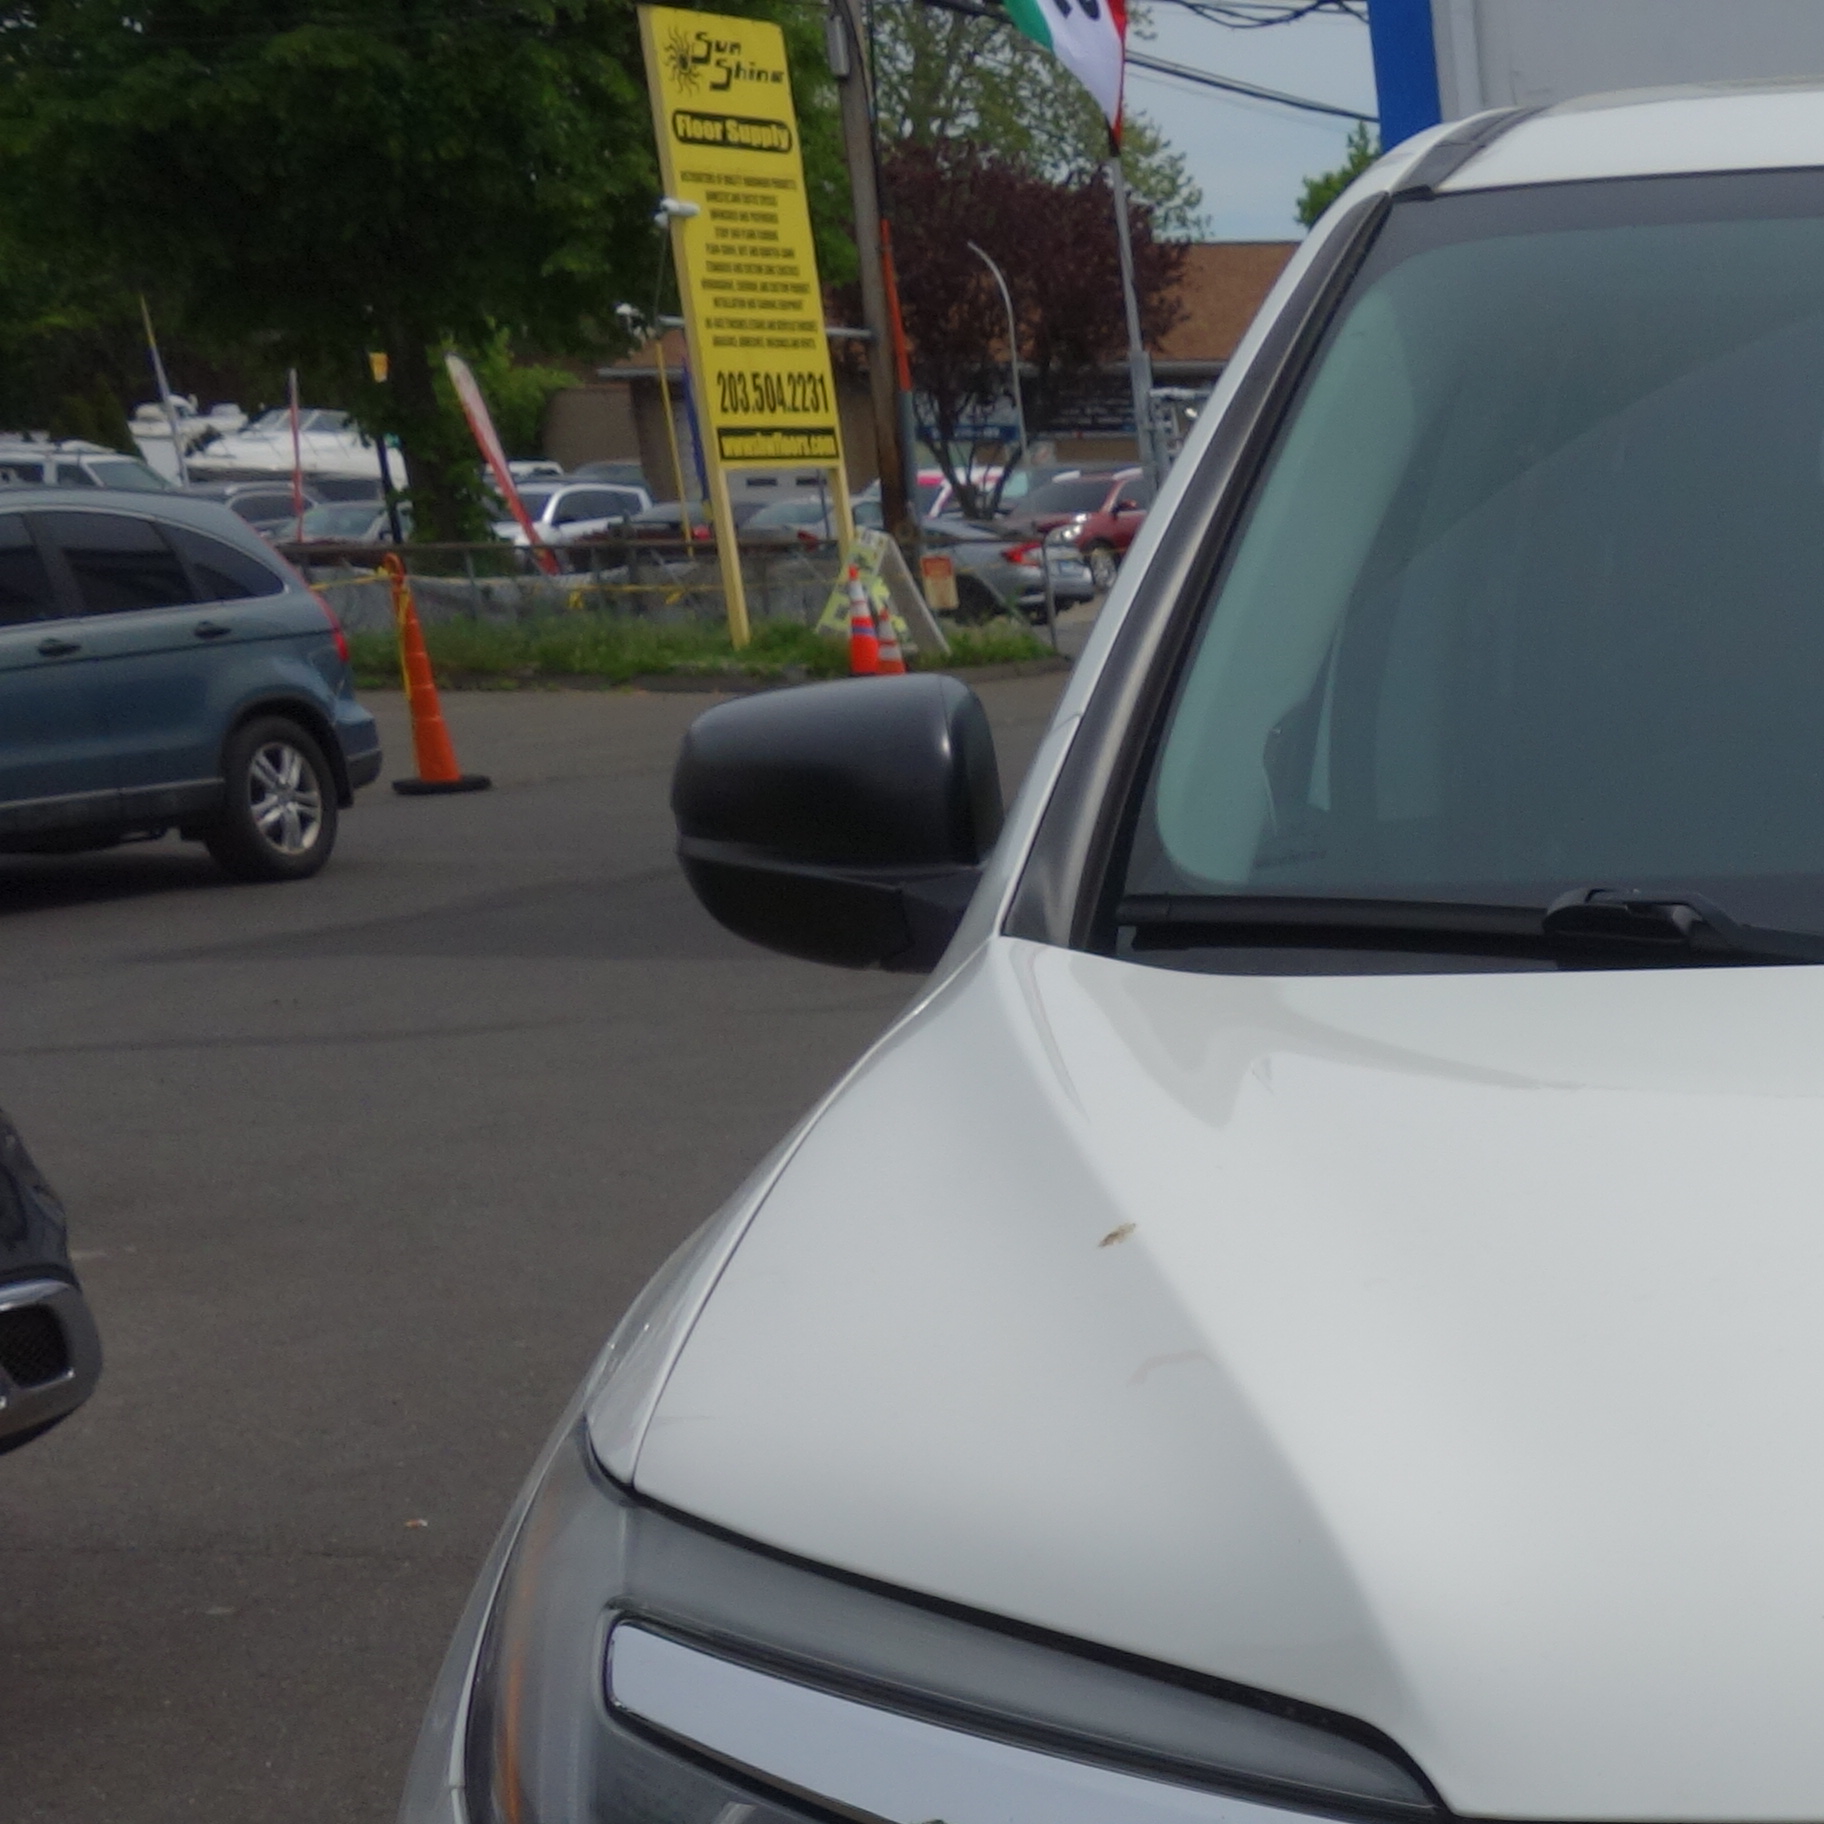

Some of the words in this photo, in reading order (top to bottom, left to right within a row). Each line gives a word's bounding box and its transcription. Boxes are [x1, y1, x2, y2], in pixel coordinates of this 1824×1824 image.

[691, 31, 741, 65] Sun
[709, 58, 785, 91] Shine
[677, 114, 723, 142] Floor
[726, 119, 790, 149] Supply
[717, 369, 830, 414] 203.504.2231
